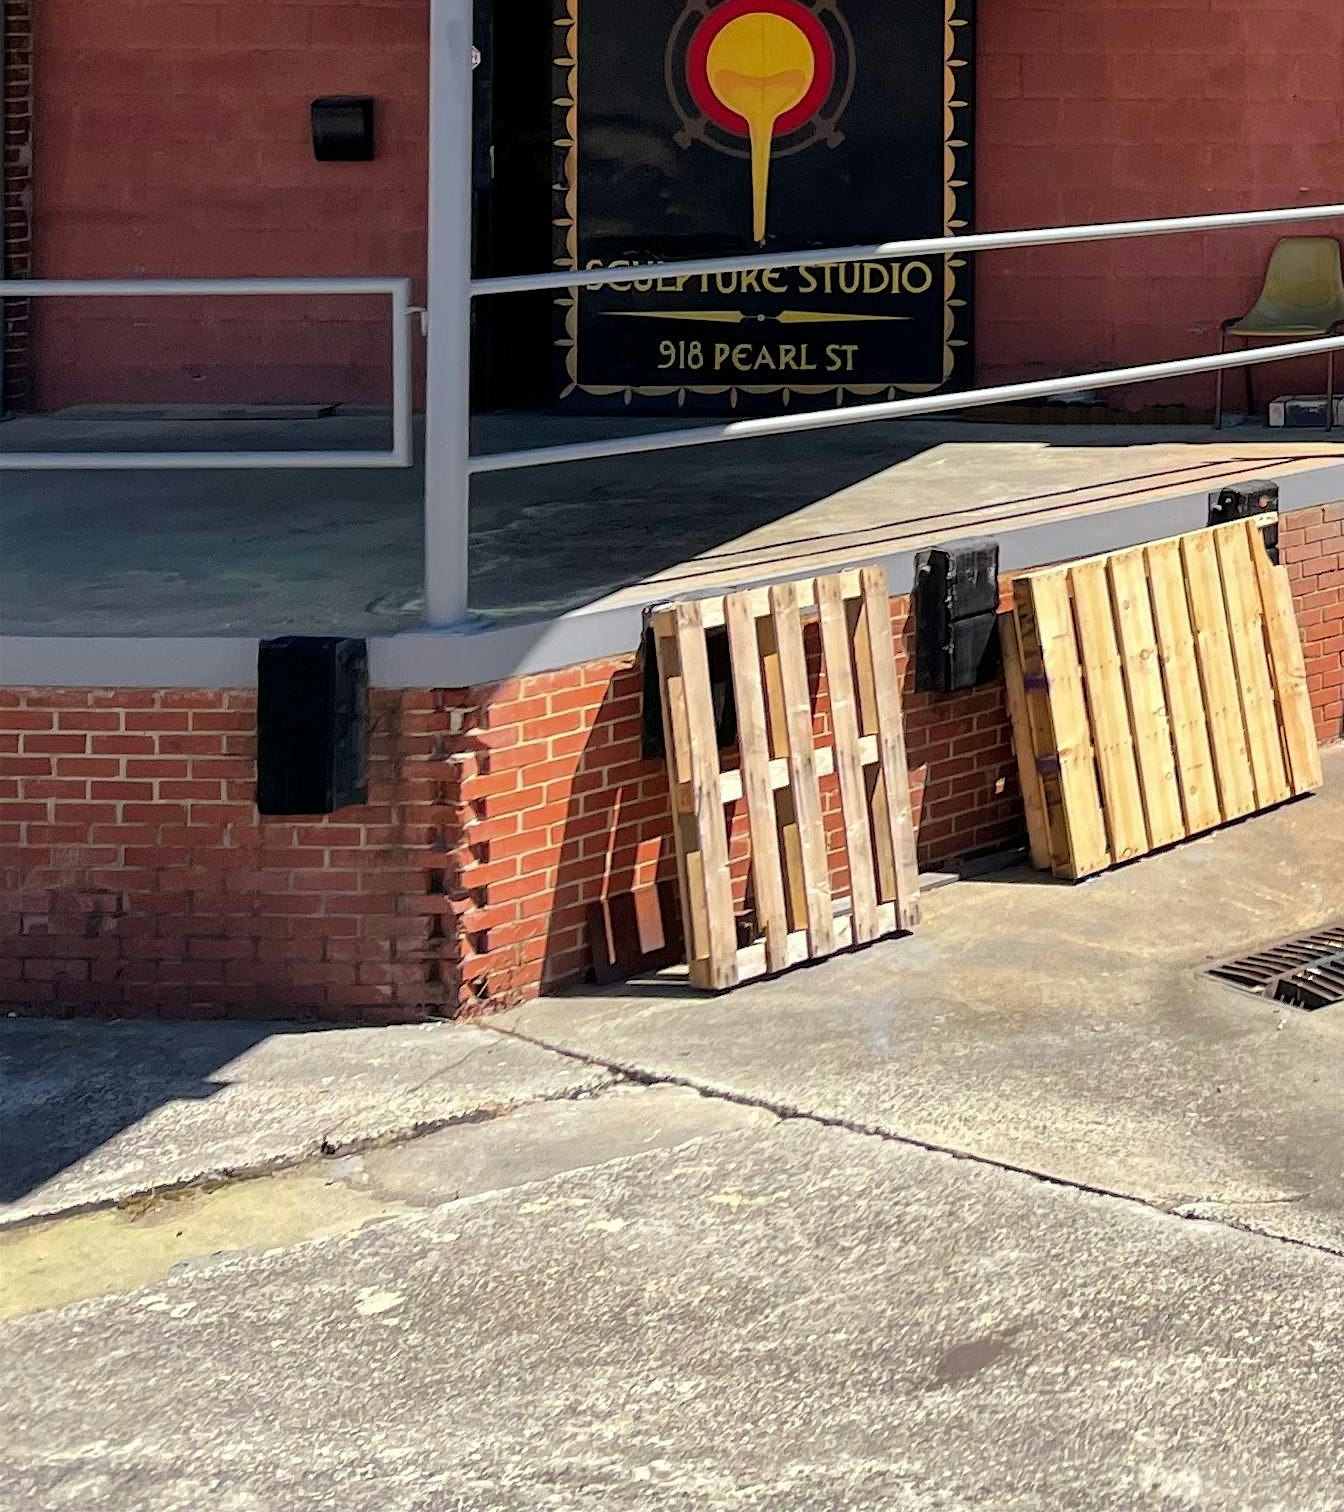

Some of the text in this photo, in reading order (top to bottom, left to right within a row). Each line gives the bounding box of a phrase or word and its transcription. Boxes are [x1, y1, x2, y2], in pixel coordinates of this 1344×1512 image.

[798, 262, 932, 293] STUDIO
[657, 340, 859, 370] 918 PEARL ST
